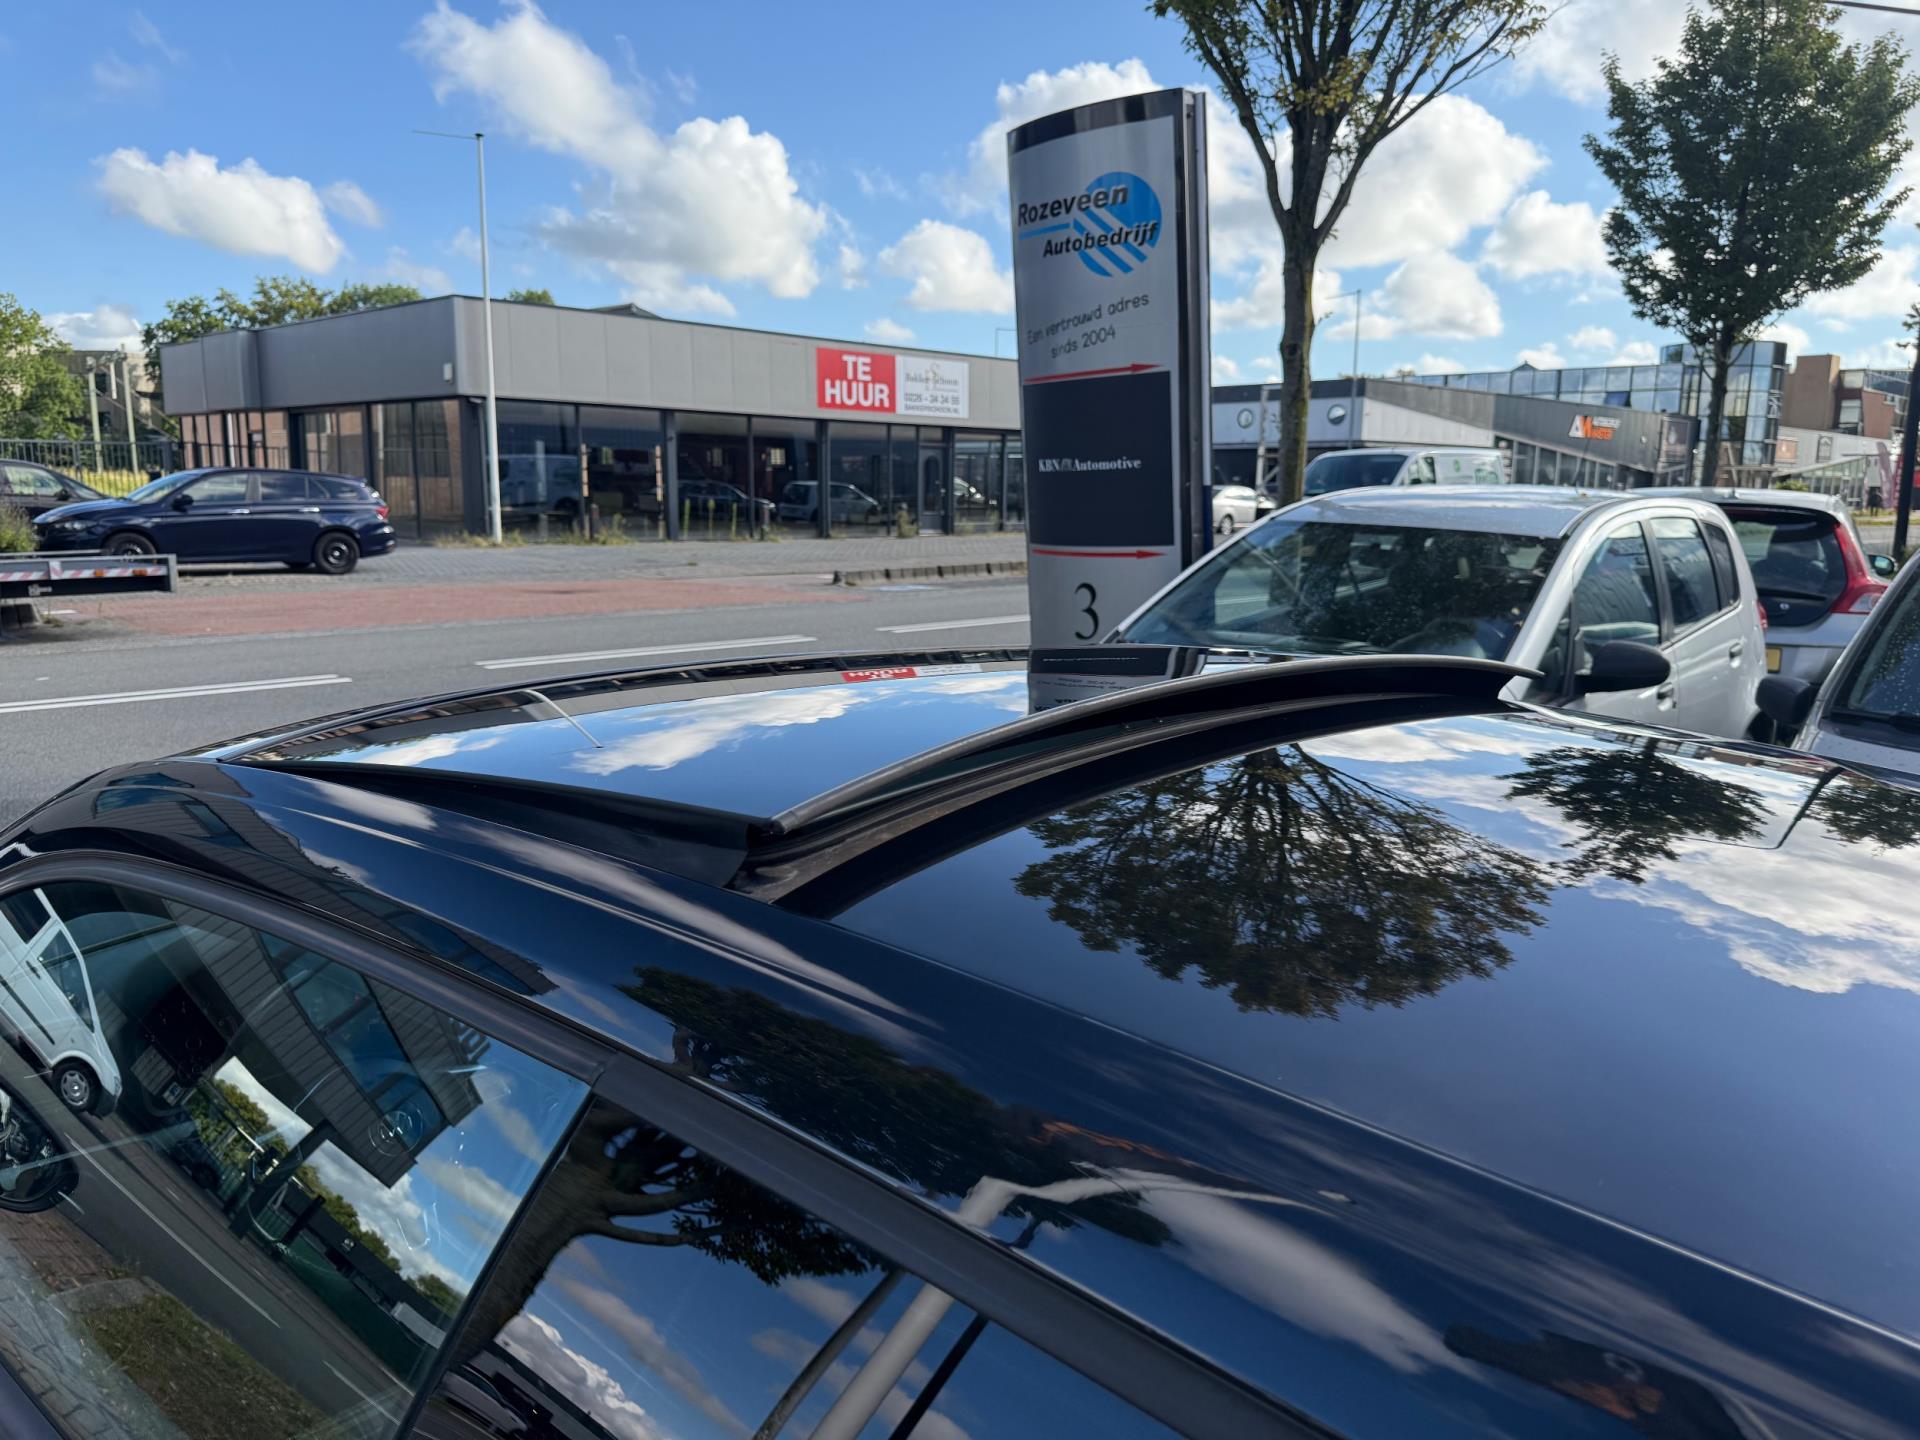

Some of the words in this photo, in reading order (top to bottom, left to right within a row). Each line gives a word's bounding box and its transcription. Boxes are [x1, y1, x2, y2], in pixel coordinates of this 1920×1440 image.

[1018, 185, 1128, 227] Rozeveen
[1043, 222, 1158, 257] Autobedrijf
[1045, 304, 1103, 337] vertrouwd
[1107, 293, 1150, 316] adres
[1051, 338, 1079, 358] sinds
[1082, 324, 1116, 348] 2004
[842, 354, 872, 382] TE
[824, 378, 890, 408] HUUR
[1074, 582, 1100, 640] 3
